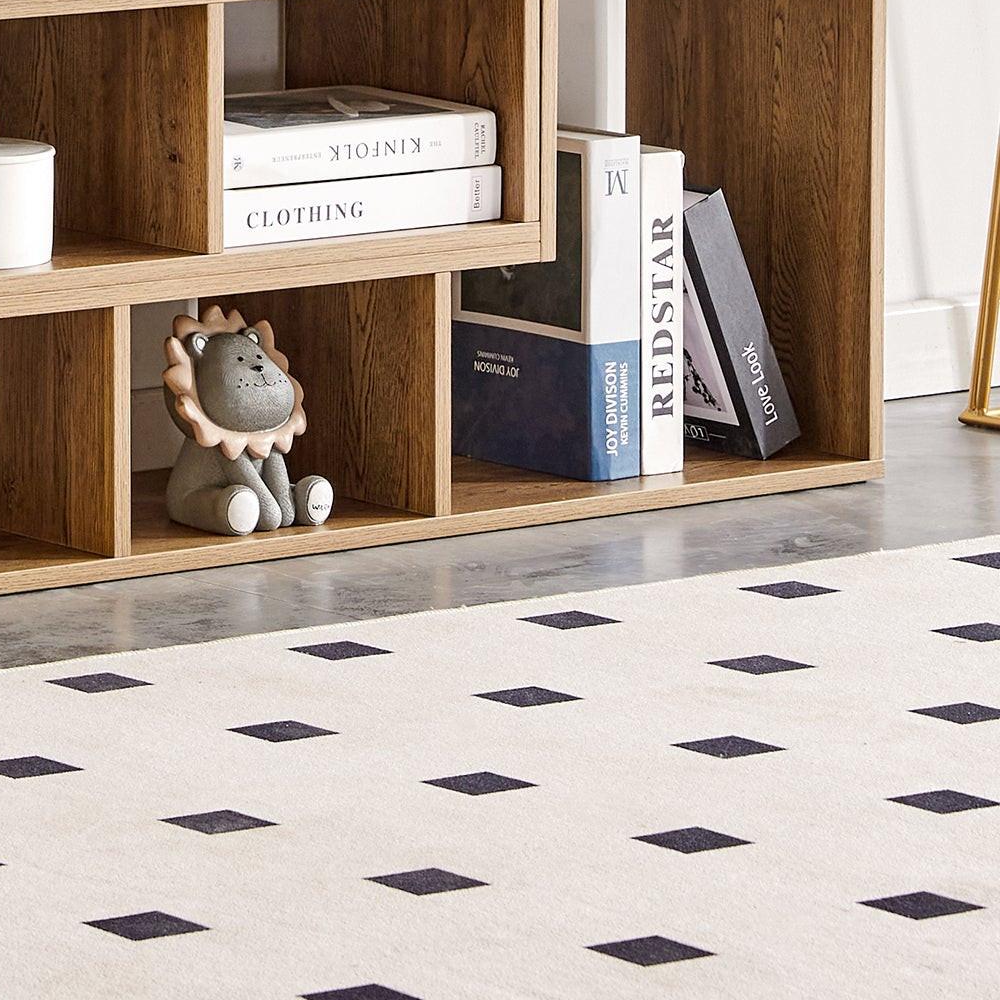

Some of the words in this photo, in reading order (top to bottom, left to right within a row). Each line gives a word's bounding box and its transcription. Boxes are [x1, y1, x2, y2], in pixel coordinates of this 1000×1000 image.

[329, 137, 421, 162] KINFOLK
[604, 168, 629, 197] M
[246, 200, 364, 230] CLOTHING
[651, 213, 674, 419] REDSTAR
[473, 360, 505, 376] DIVISON
[501, 354, 514, 363] KEVIN
[505, 365, 520, 378] JOY
[740, 341, 765, 385] Look
[605, 361, 618, 425] DIVISON
[619, 362, 629, 413] CUMMINS
[757, 384, 779, 426] Love
[605, 428, 618, 457] JOY
[619, 414, 629, 445] KEVIN
